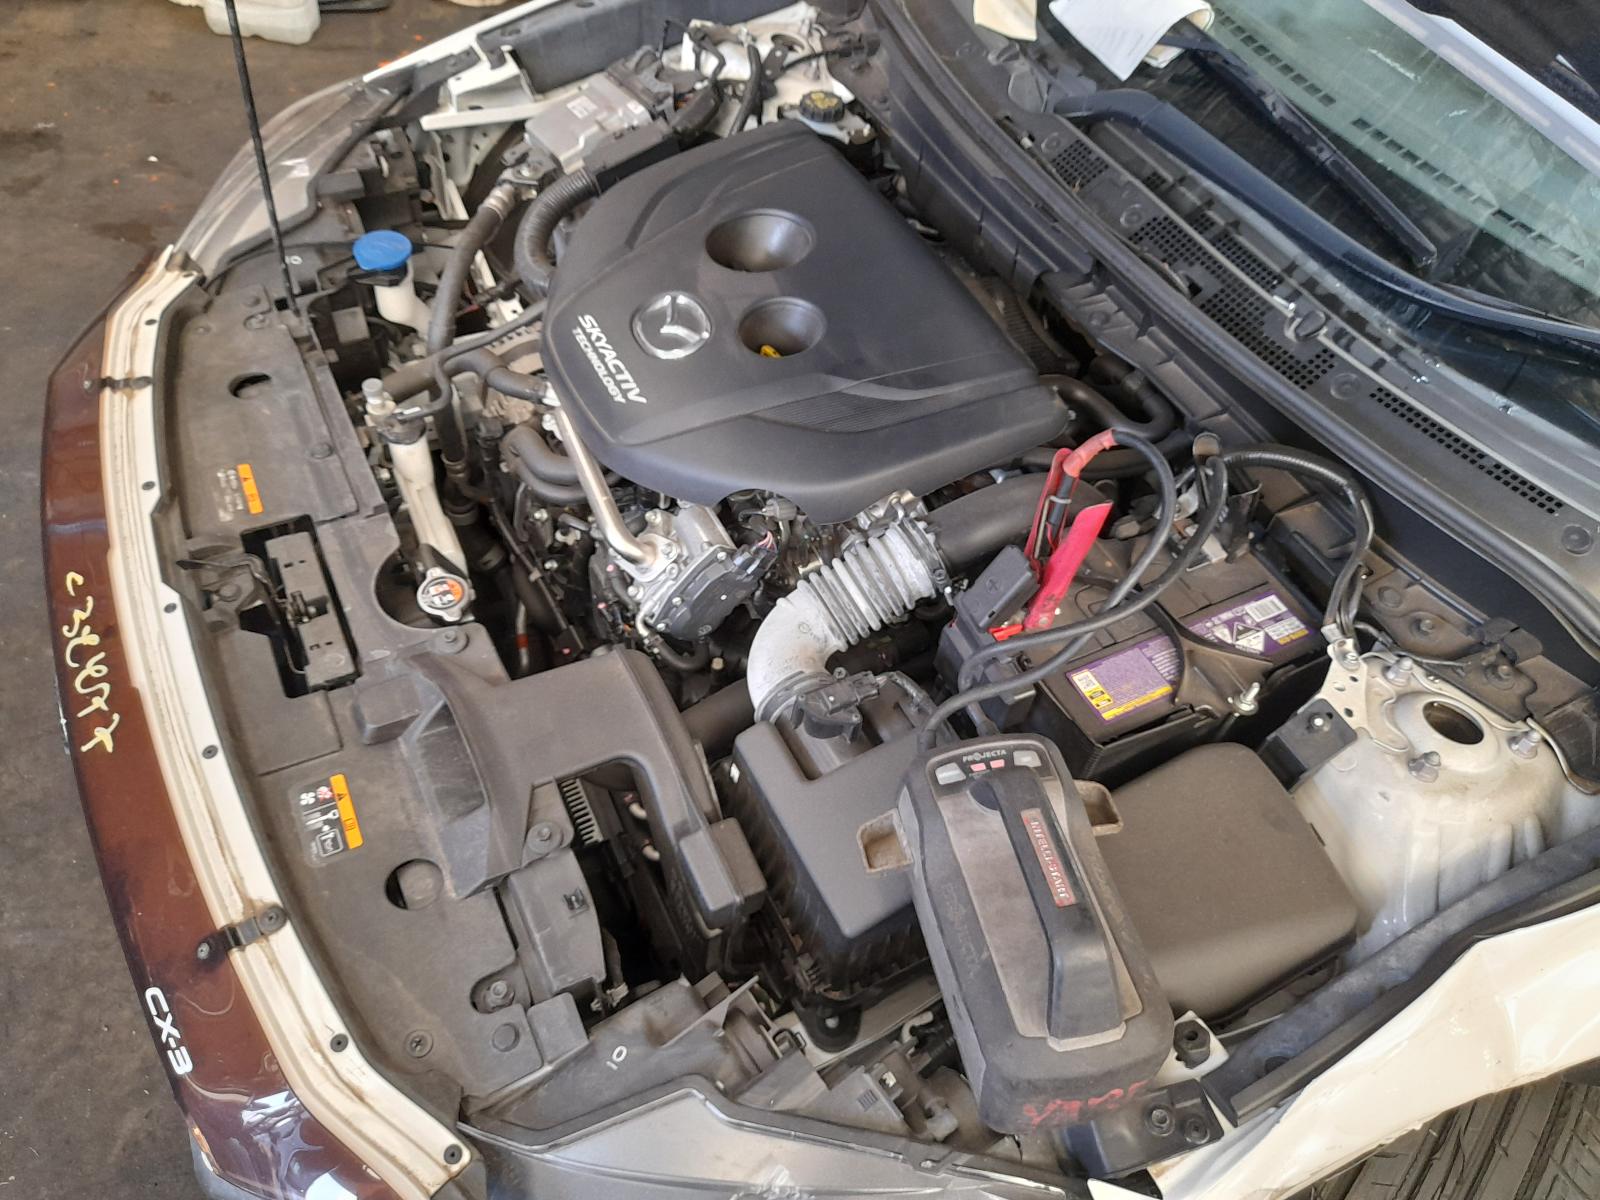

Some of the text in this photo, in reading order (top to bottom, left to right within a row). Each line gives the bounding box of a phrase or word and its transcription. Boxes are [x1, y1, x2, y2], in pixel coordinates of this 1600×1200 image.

[572, 326, 626, 404] TECHNOLOGY
[577, 314, 647, 404] SKYACTIV
[962, 749, 1007, 762] PROJECTA
[145, 987, 193, 1075] CX-3
